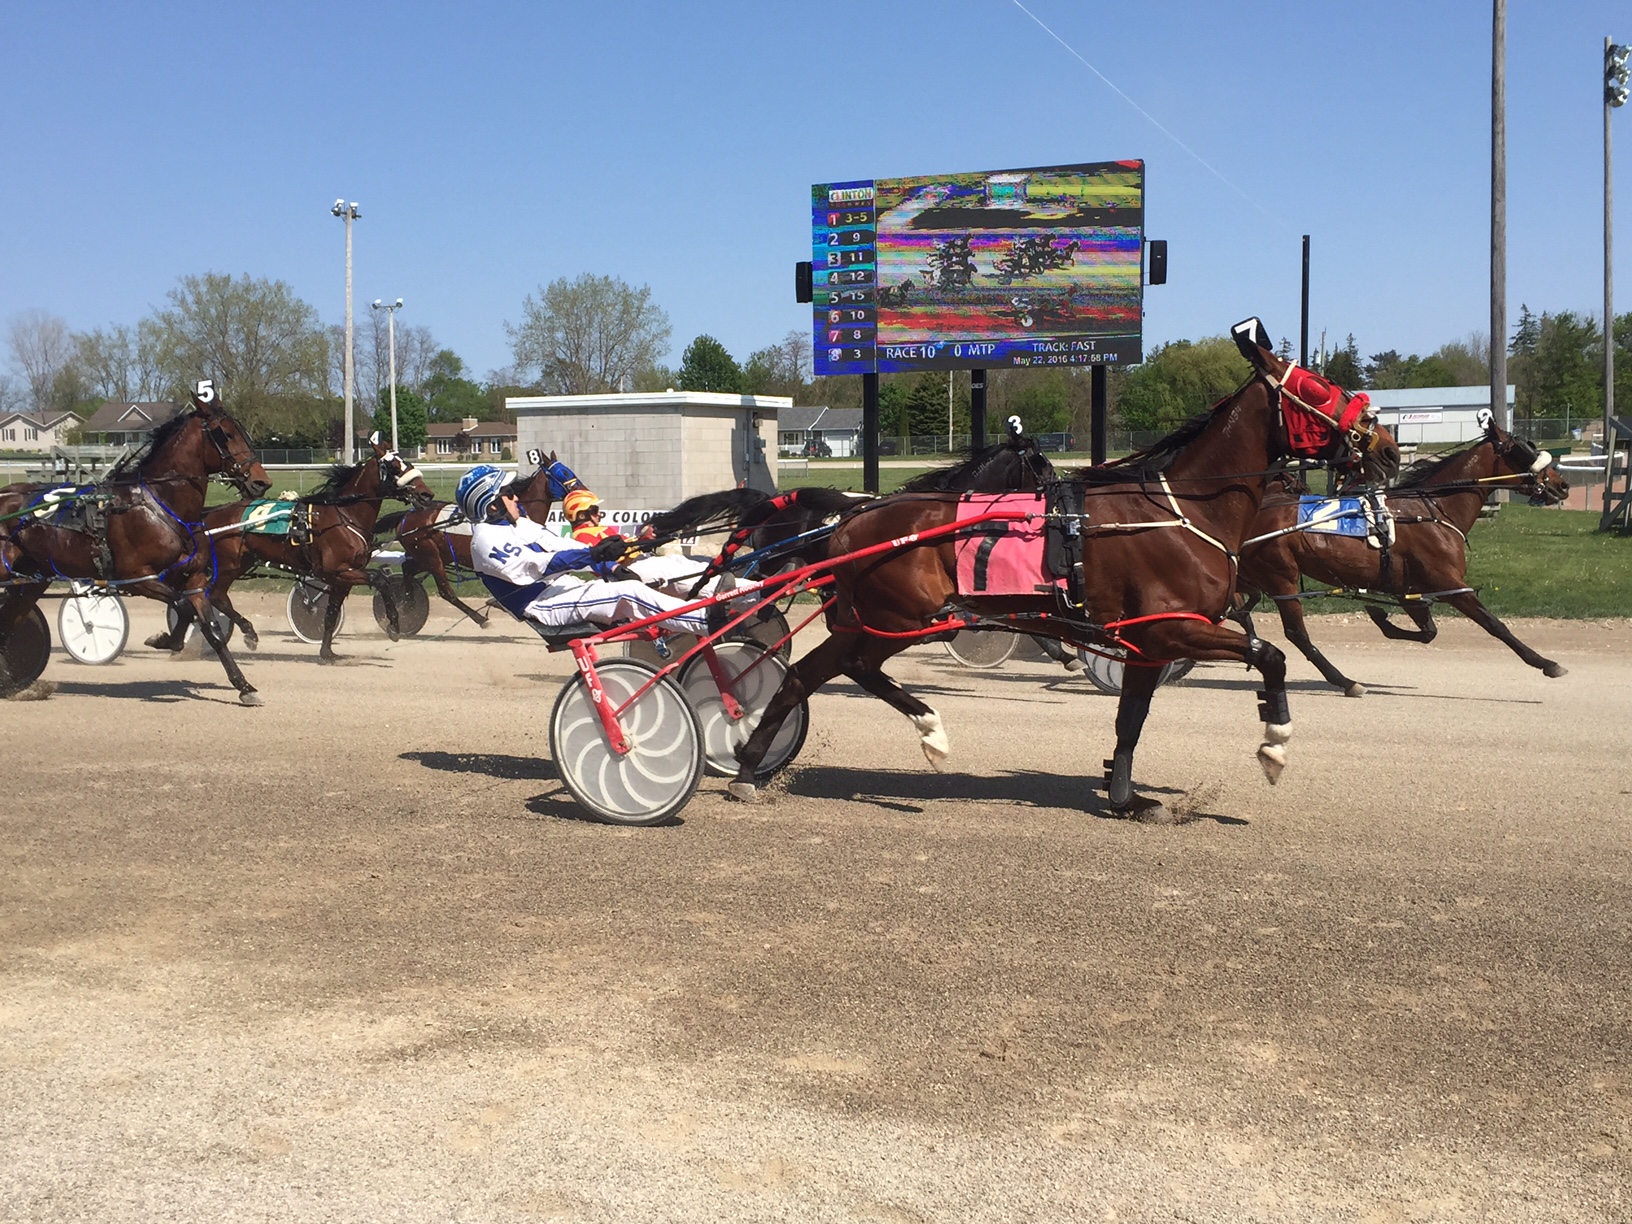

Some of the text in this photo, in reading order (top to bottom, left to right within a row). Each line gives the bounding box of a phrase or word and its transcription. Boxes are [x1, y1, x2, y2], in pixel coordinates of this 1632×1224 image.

[831, 189, 872, 200] CLINTON
[830, 212, 867, 225] 1 3-5
[830, 232, 860, 245] 2 9
[829, 252, 863, 265] 3 11
[830, 271, 865, 284] 4 12
[830, 291, 865, 304] 5 15
[831, 310, 865, 323] 6 10
[831, 329, 861, 342] 7 8
[1234, 318, 1258, 344] 7
[886, 343, 996, 359] RACE 10 0 MTP
[1032, 340, 1097, 353] TRACK: FAST
[831, 348, 861, 361] 8 3
[1013, 356, 1031, 367] May
[1047, 354, 1068, 364] 2016
[1103, 353, 1118, 362] PM
[197, 379, 215, 403] 5
[1008, 415, 1023, 435] 3
[369, 430, 380, 446] 4
[528, 449, 541, 465] 8
[248, 502, 277, 530] 4
[959, 519, 1009, 591] 7
[715, 588, 739, 601] Garrett
